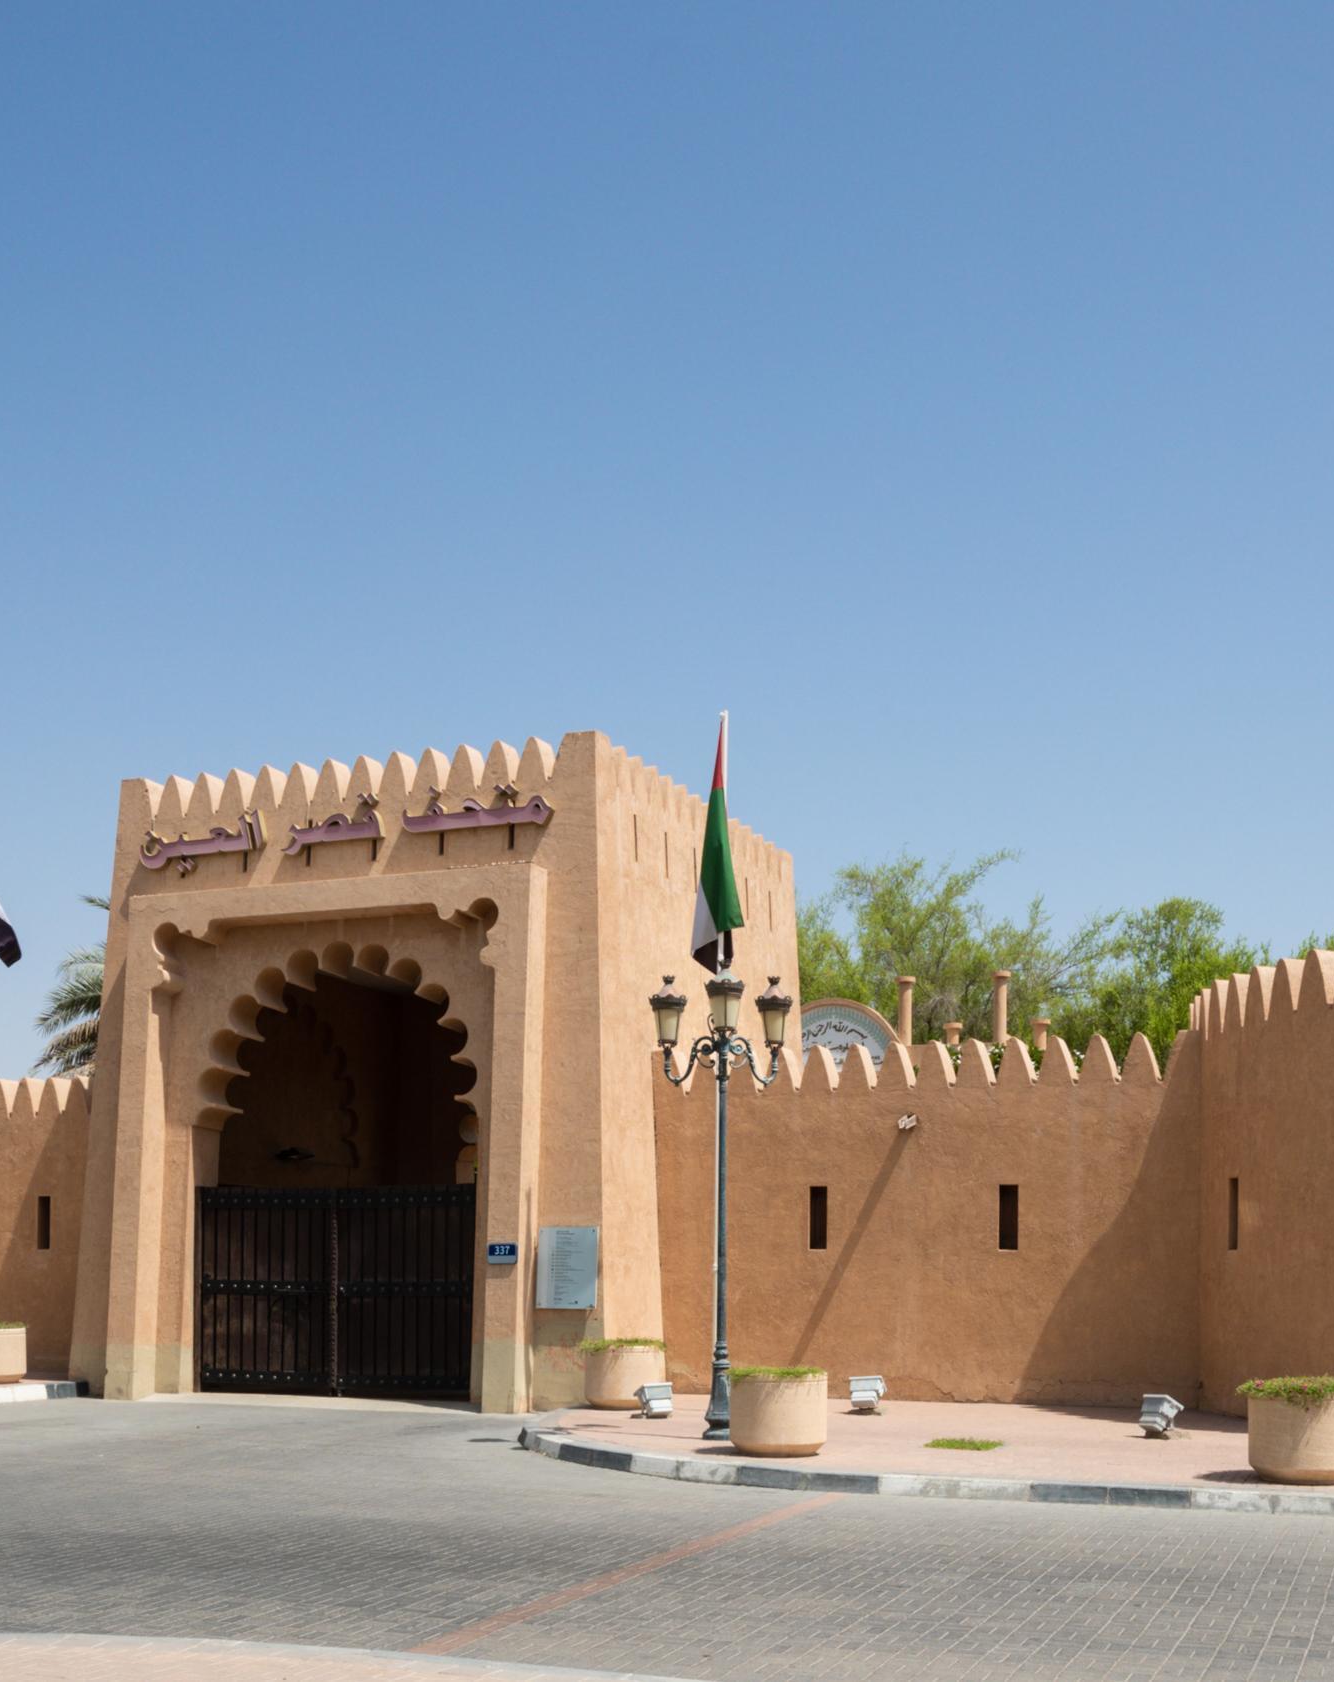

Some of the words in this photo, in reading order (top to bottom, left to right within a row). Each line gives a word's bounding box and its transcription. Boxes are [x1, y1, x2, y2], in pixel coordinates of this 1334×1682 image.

[282, 792, 386, 856] قصر
[402, 783, 555, 833] متحف
[140, 808, 267, 874] العين
[494, 1245, 510, 1255] 337
